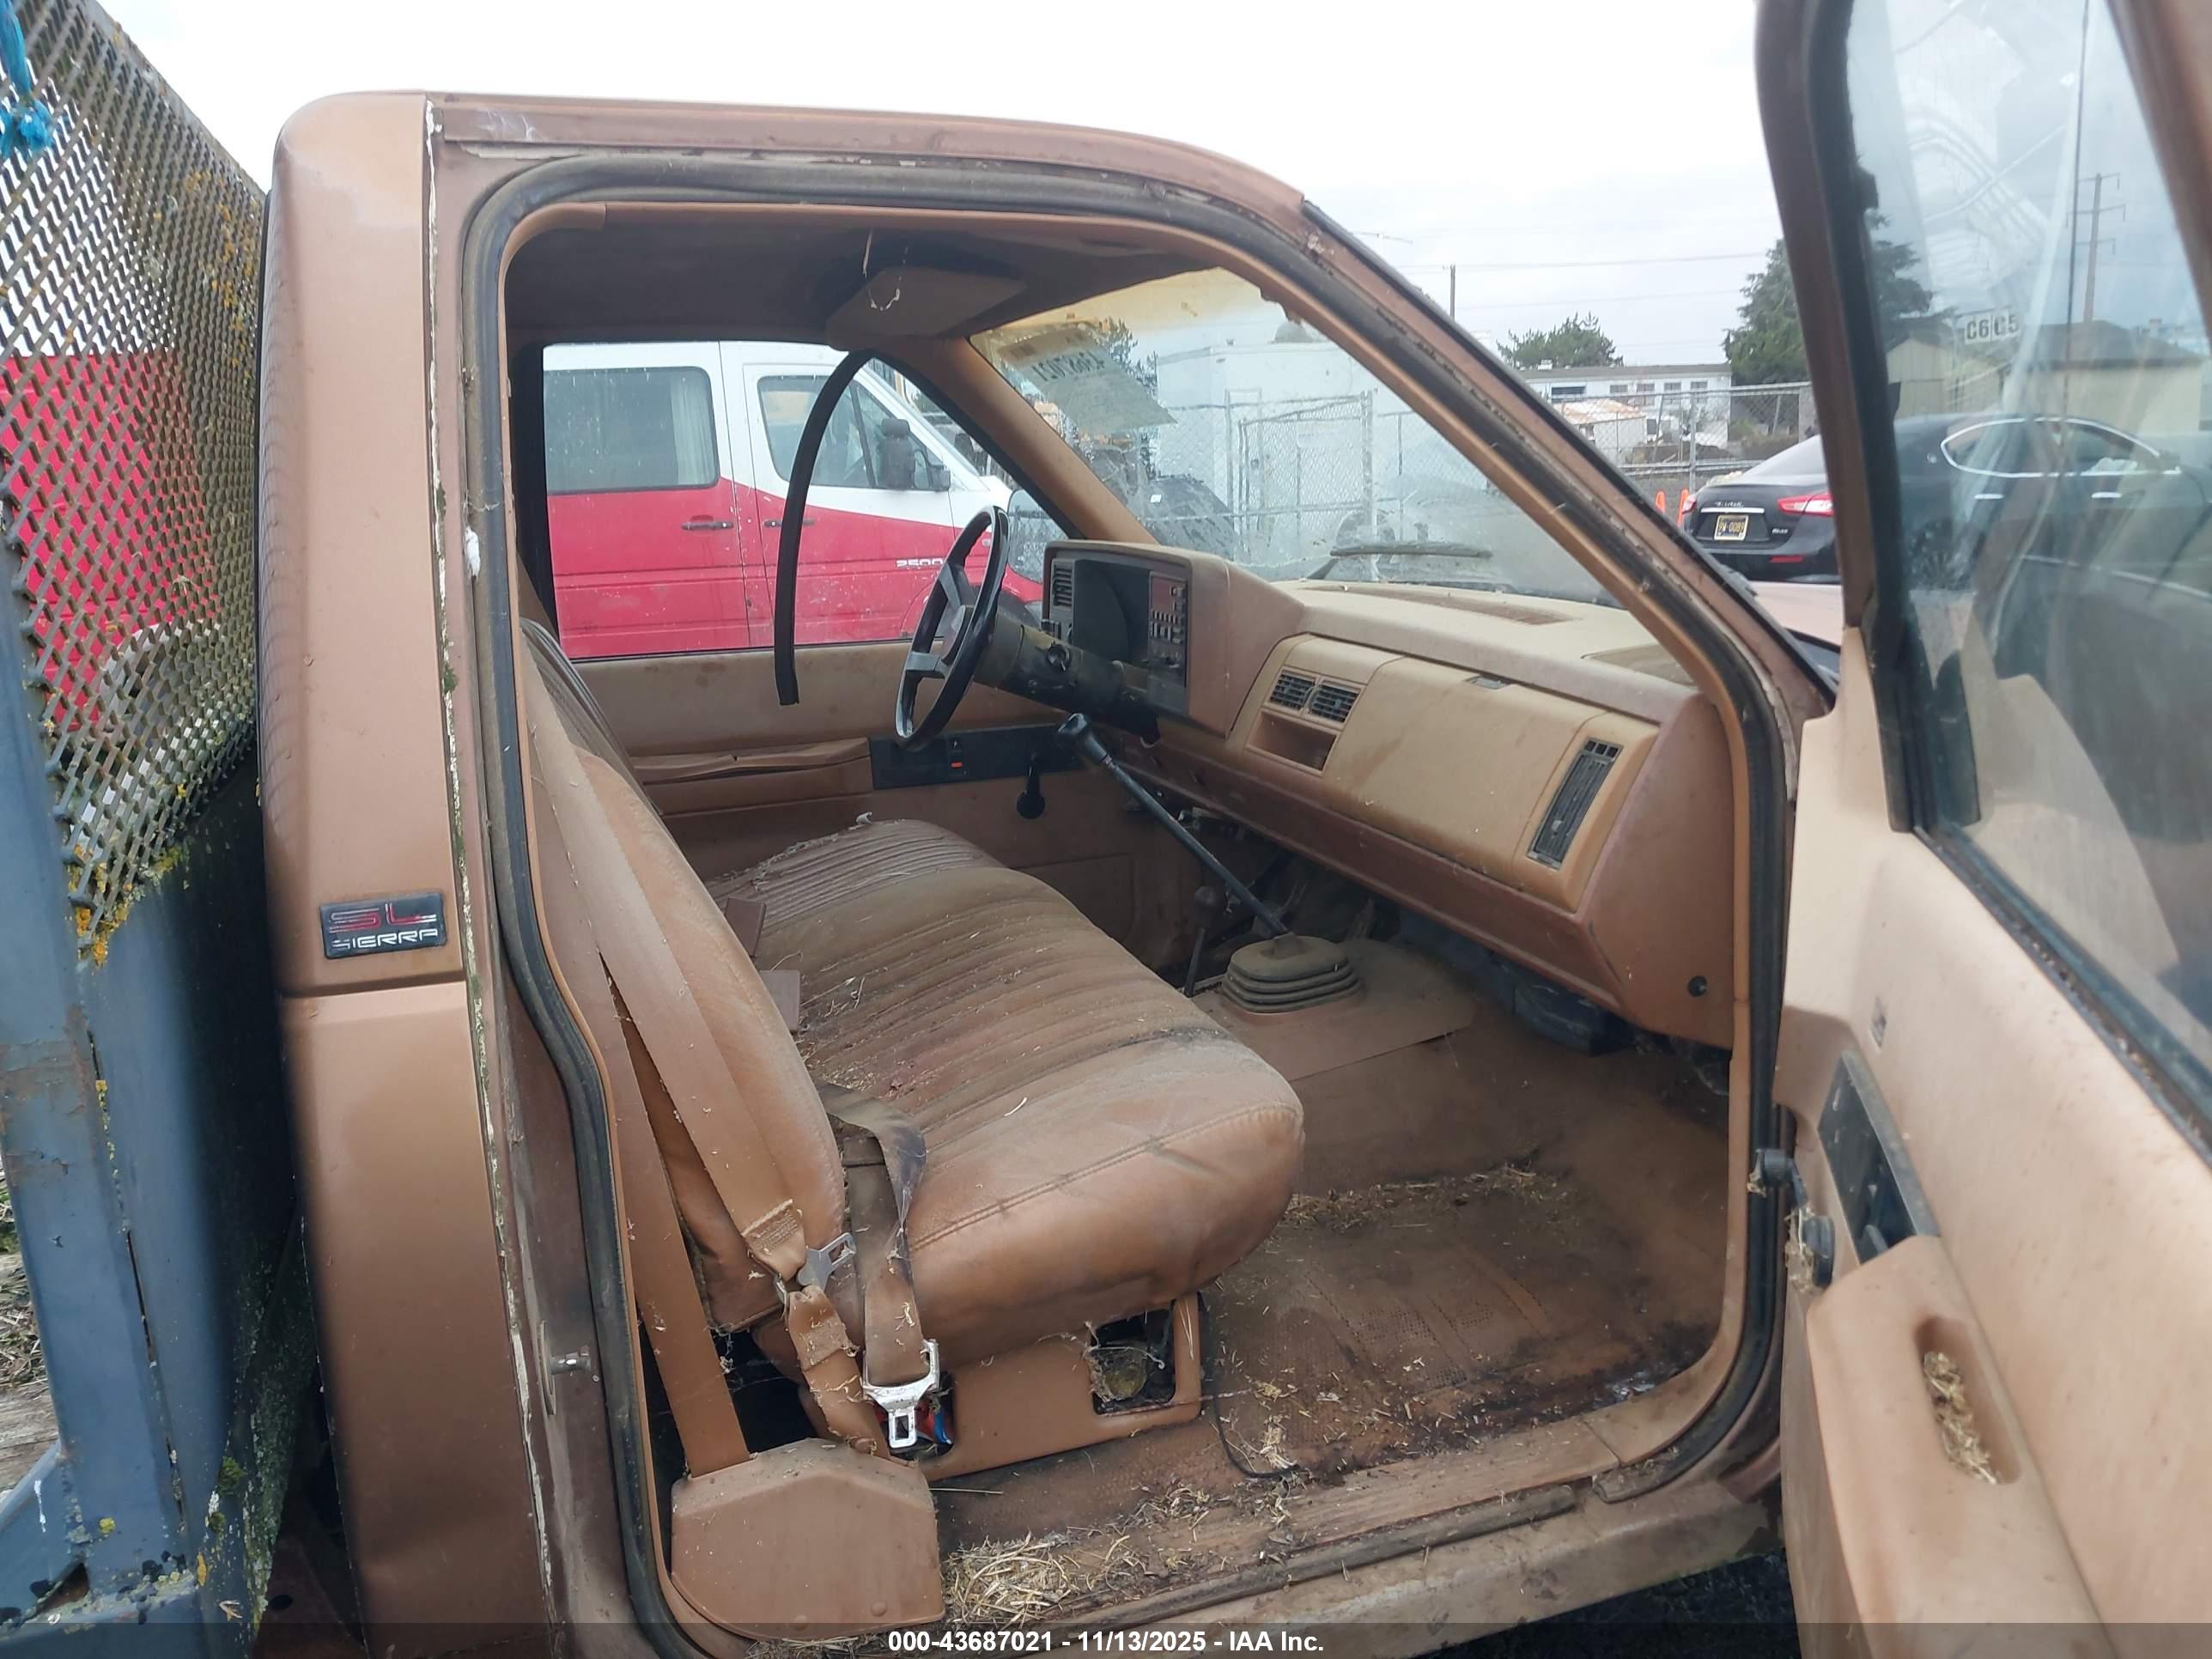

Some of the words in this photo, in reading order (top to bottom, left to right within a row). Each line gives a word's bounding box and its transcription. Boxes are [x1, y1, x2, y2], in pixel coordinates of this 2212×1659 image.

[896, 557, 944, 568] 2500
[329, 902, 437, 934] SL
[331, 928, 439, 950] SIERRA
